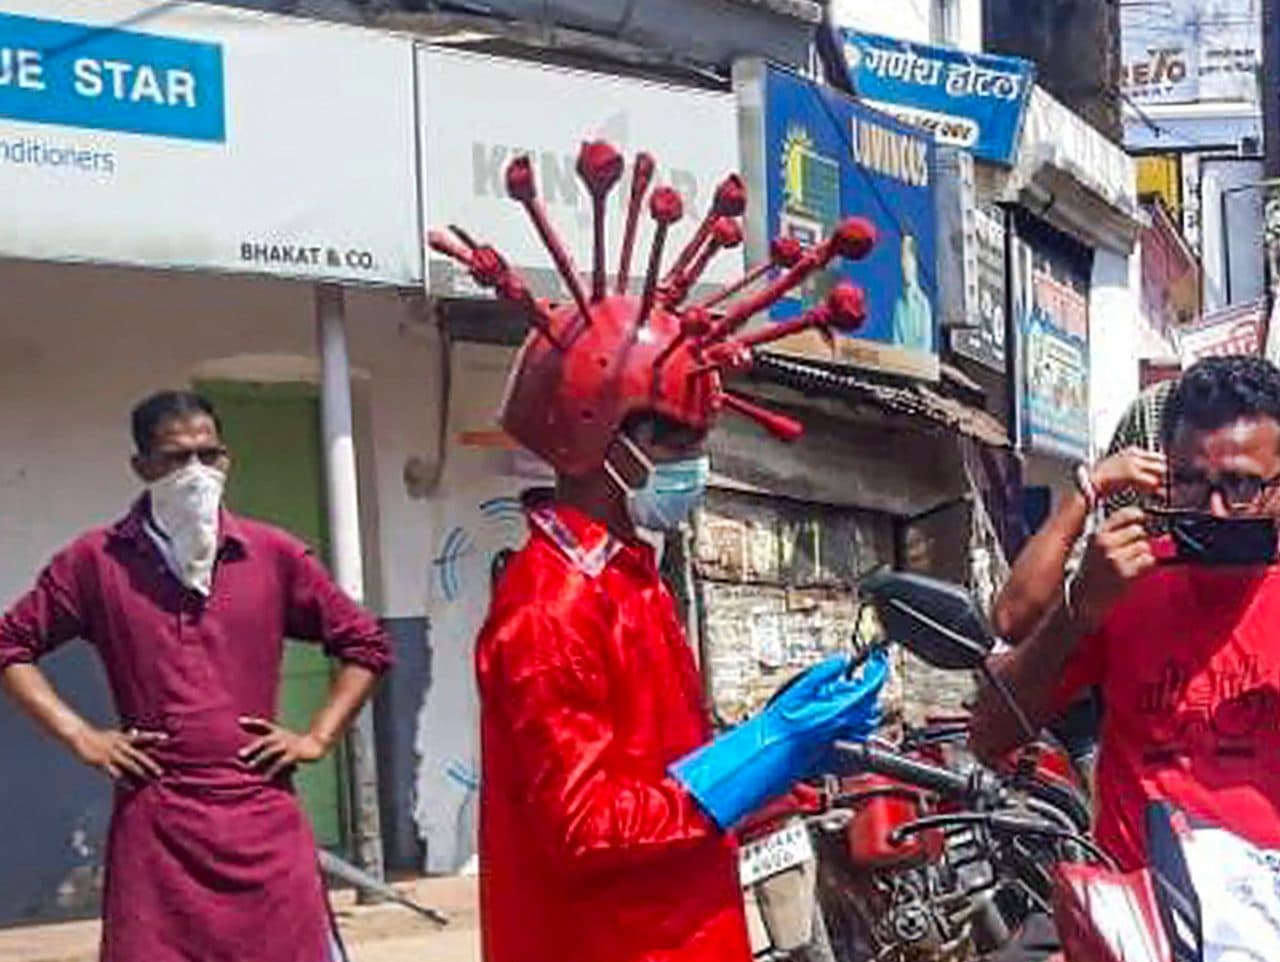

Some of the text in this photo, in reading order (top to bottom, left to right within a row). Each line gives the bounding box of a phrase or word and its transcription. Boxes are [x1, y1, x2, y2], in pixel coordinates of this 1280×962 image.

[74, 58, 196, 108] STAR
[241, 242, 321, 265] BHAKAT
[326, 247, 341, 267] &
